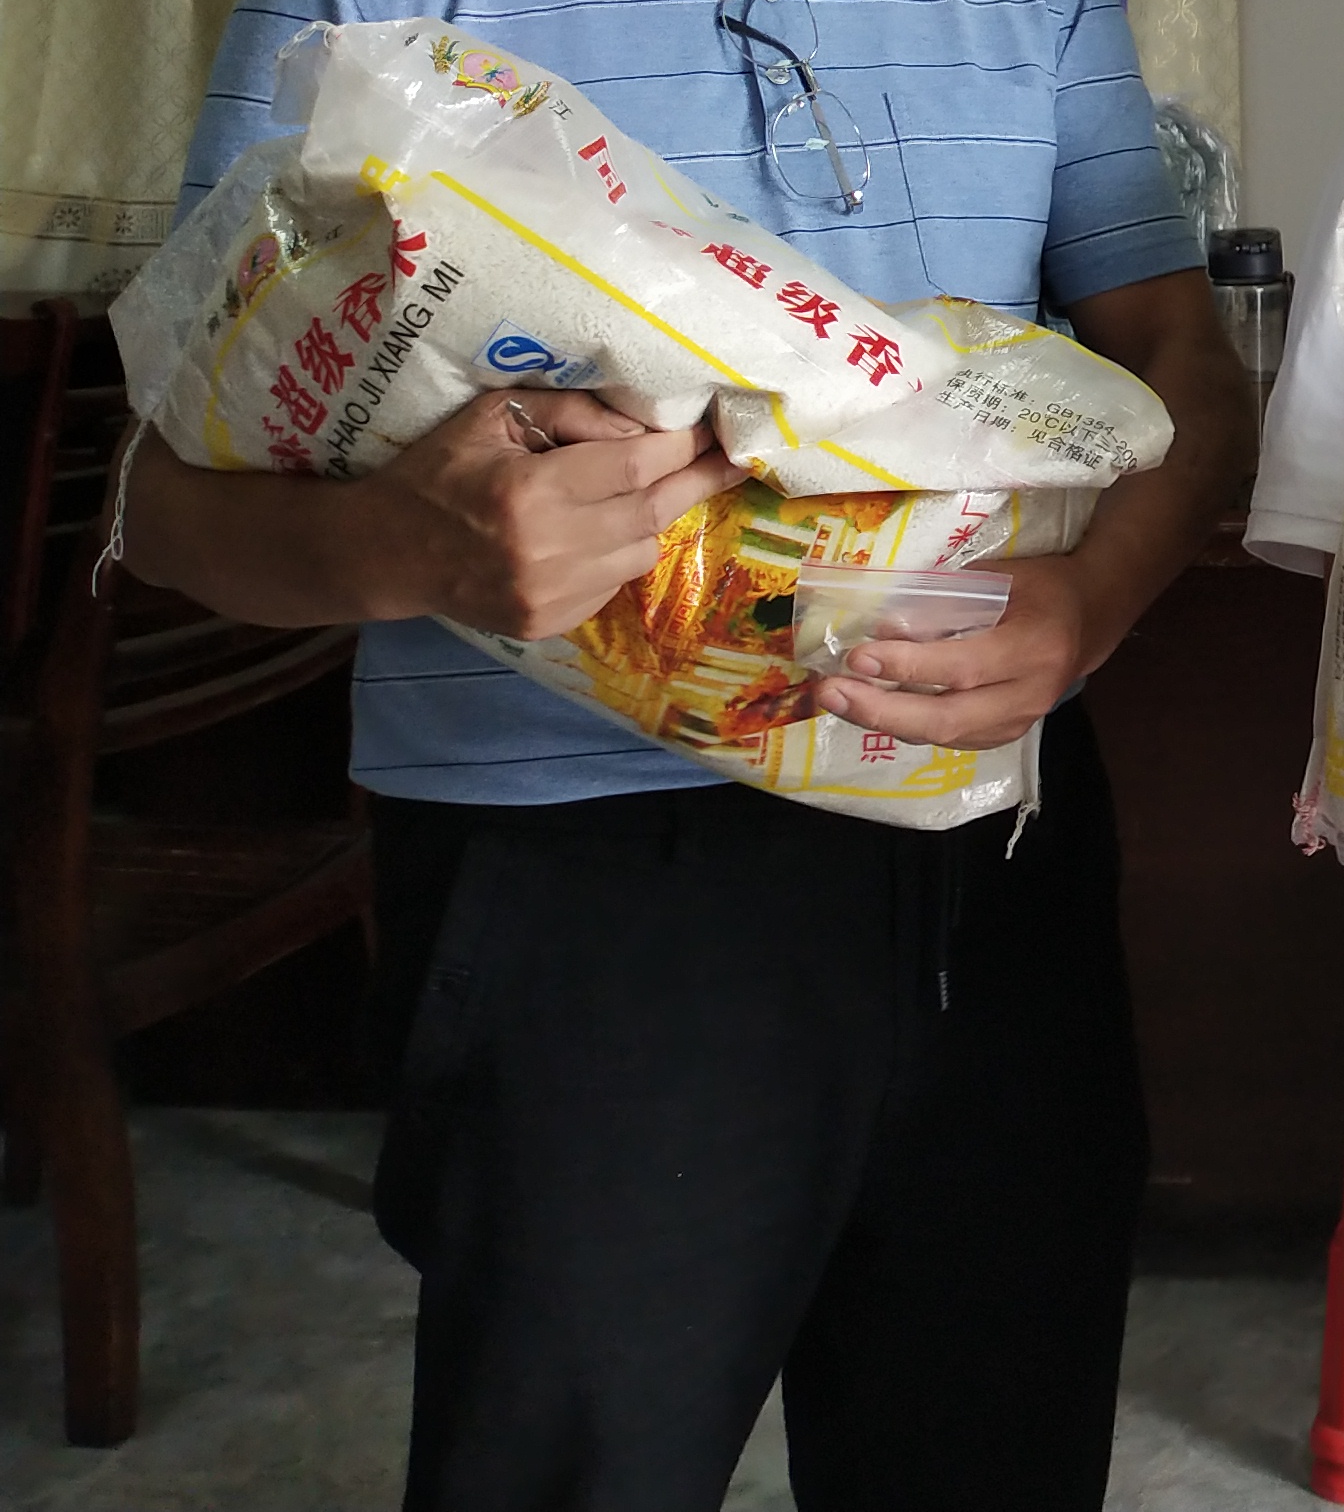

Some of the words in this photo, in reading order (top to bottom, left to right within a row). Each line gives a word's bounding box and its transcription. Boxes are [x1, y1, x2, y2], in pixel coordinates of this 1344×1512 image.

[421, 258, 464, 303] MI
[367, 299, 435, 383] XIANG
[354, 378, 386, 406] JI
[1025, 426, 1105, 471] 见合格证
